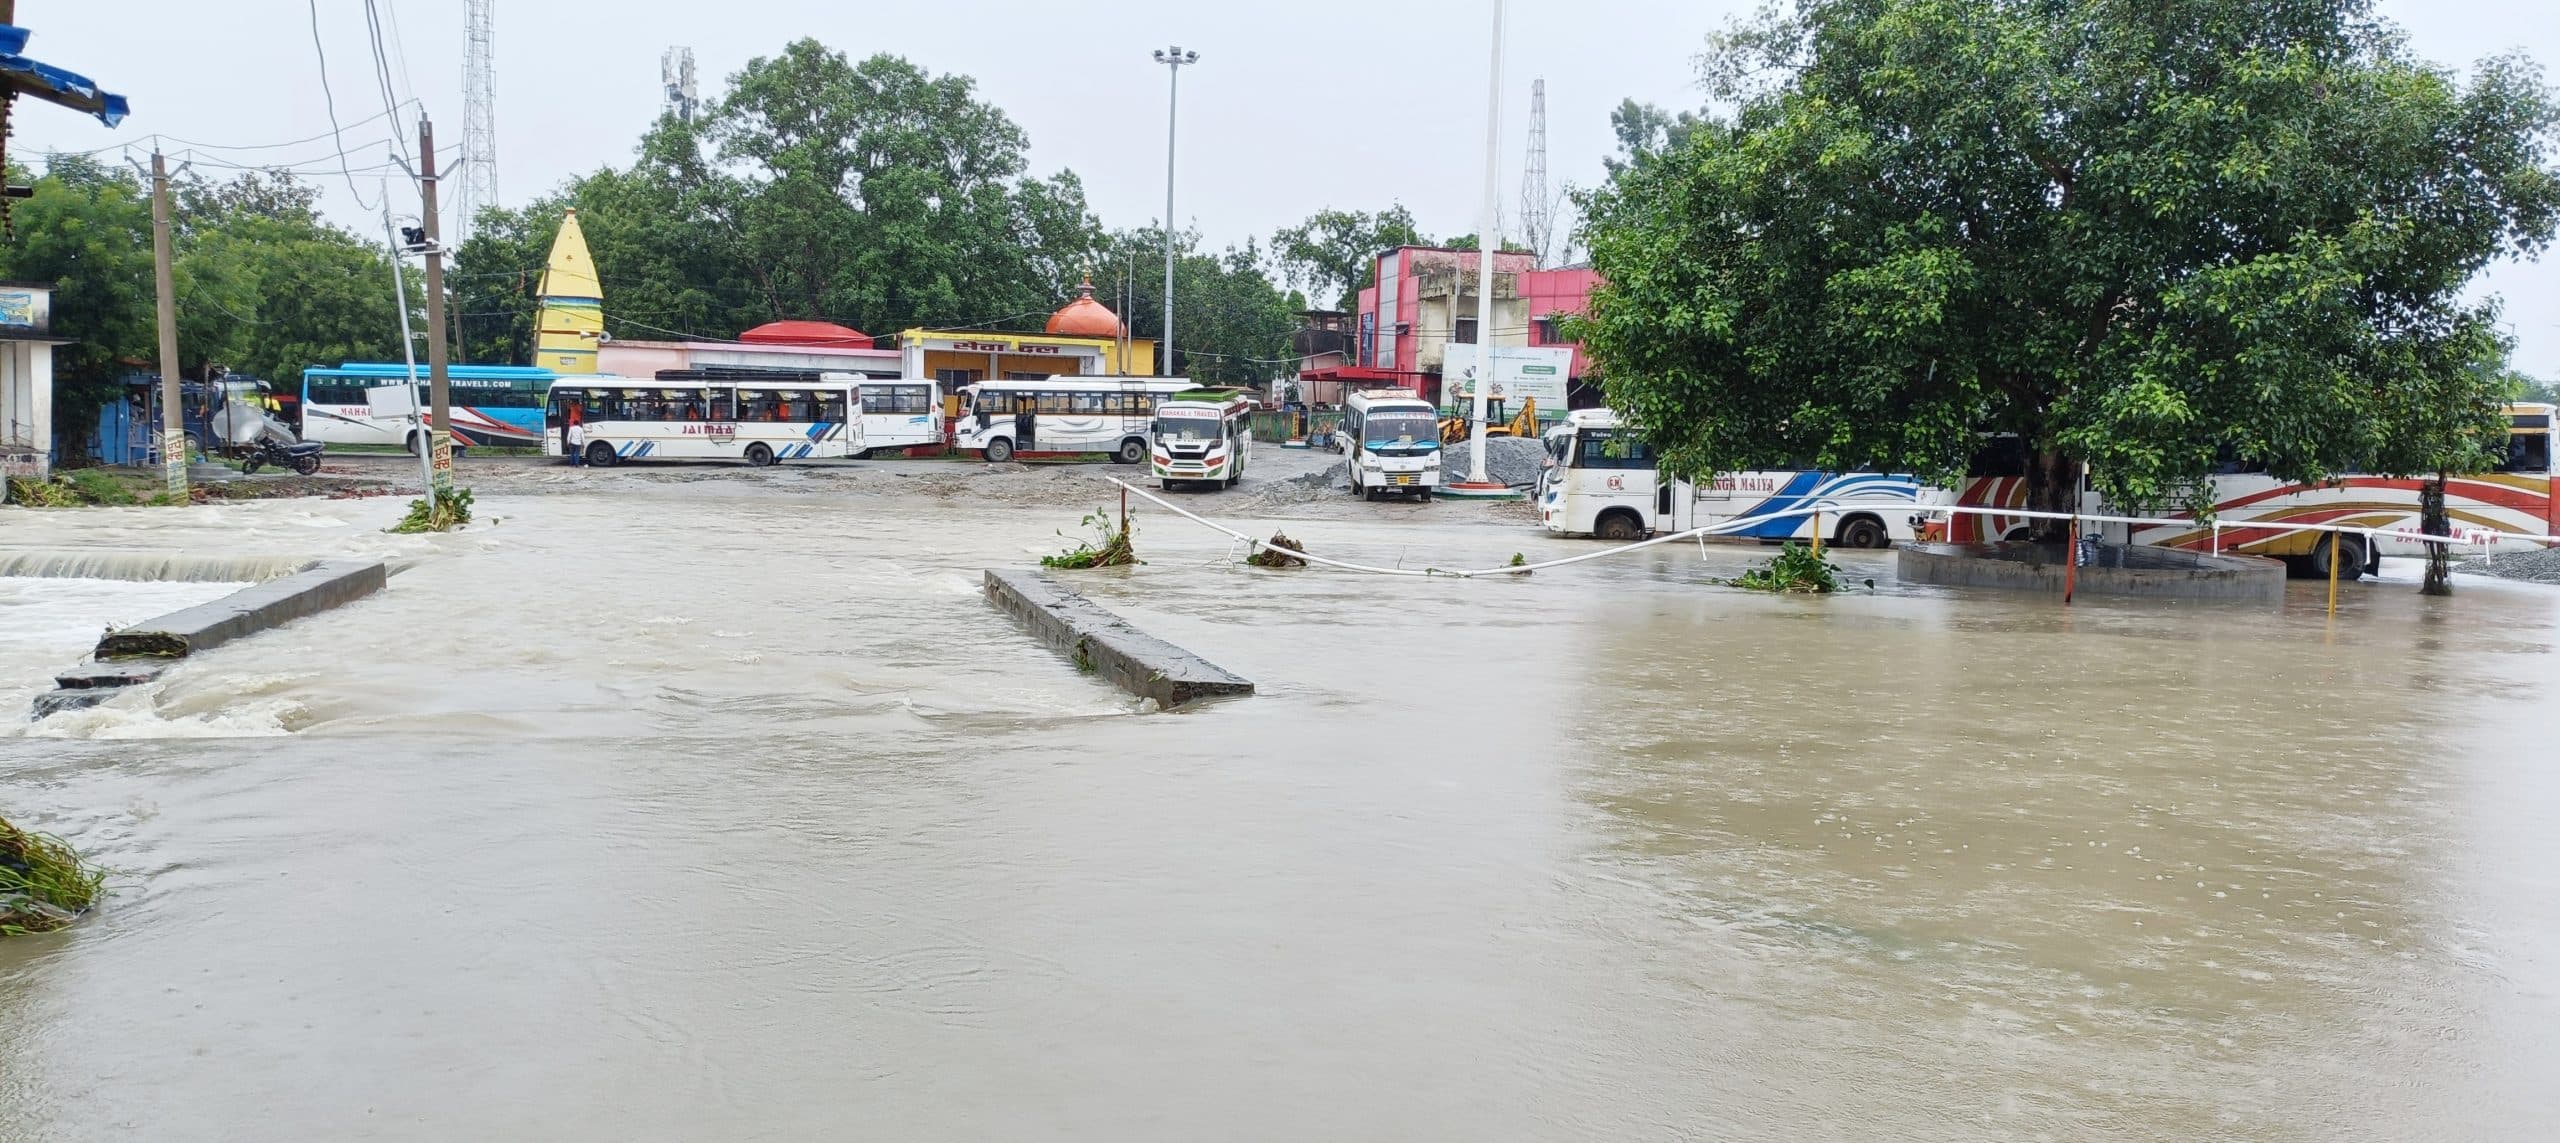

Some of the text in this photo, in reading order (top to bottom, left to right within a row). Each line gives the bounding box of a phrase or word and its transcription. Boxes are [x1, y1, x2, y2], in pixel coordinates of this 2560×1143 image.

[953, 341, 1005, 352] सेवा
[682, 424, 733, 434] JAI MAA
[1740, 478, 1774, 491] MAIYA
